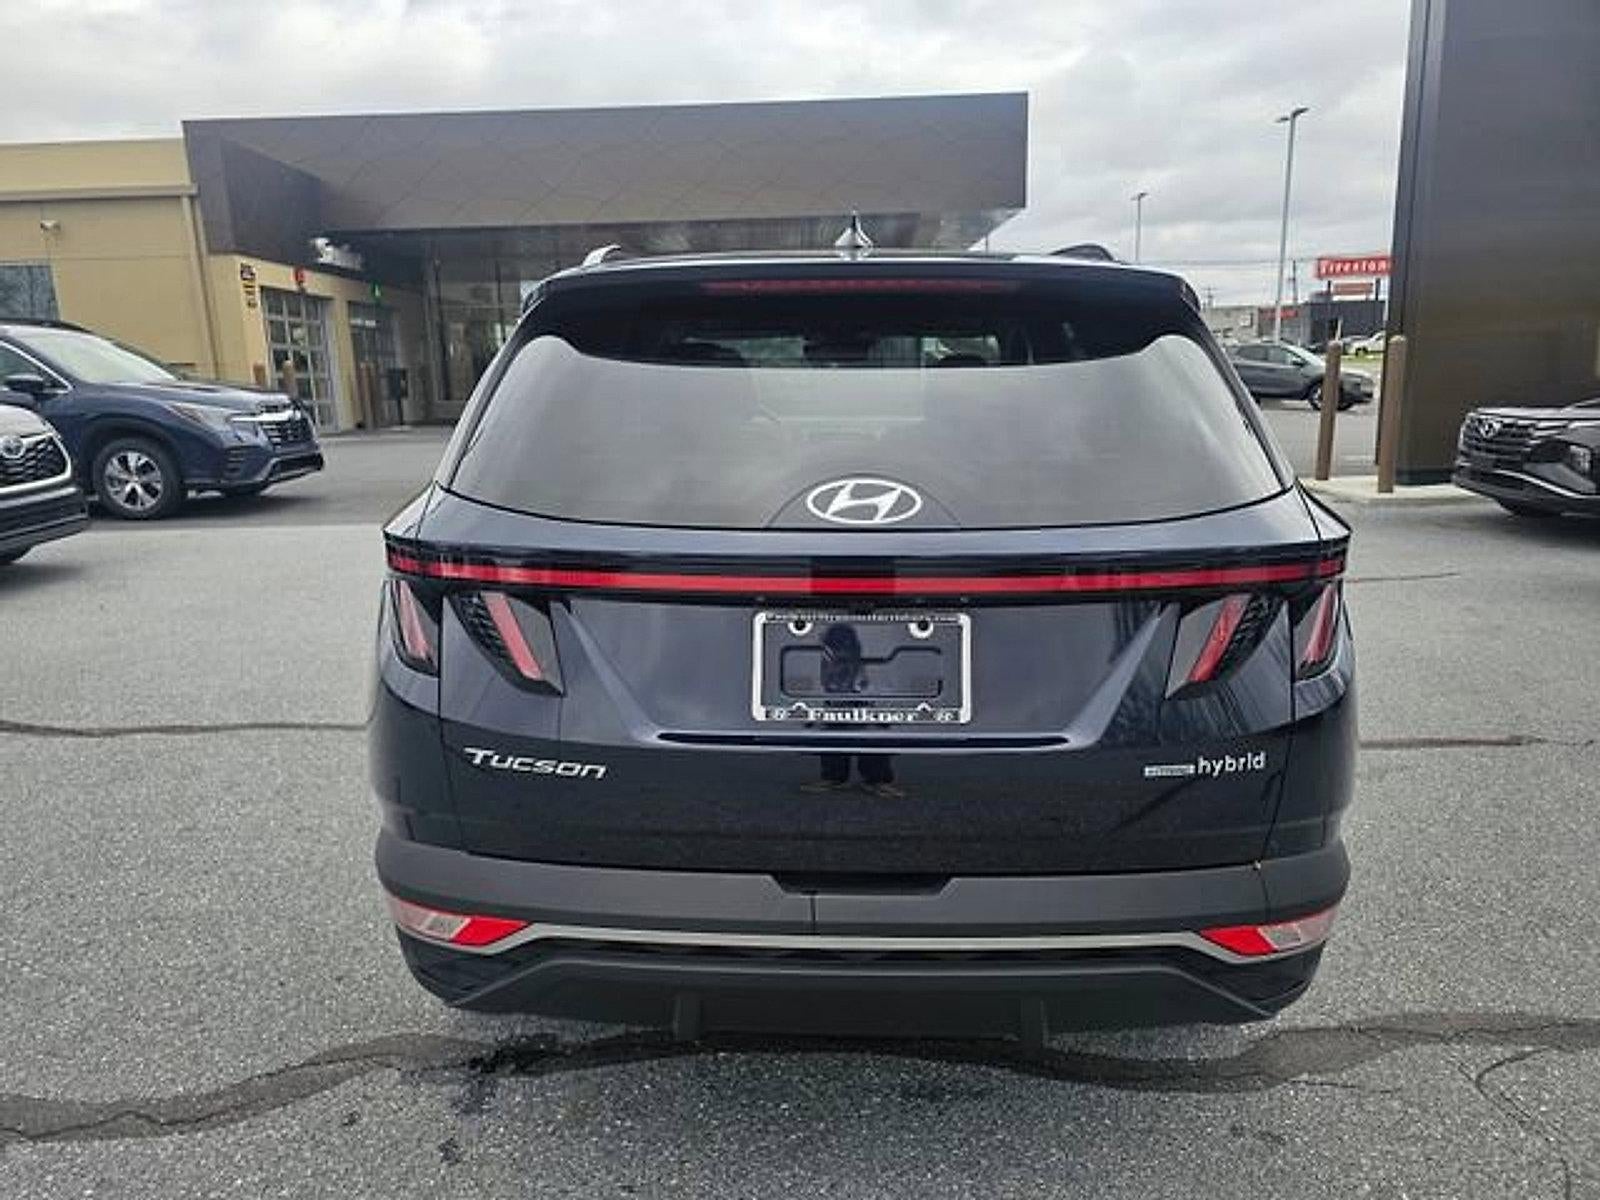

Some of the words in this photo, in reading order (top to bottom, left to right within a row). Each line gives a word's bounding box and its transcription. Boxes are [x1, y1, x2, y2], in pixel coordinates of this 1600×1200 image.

[1320, 258, 1391, 275] Fireston
[806, 706, 917, 723] Faulkner
[1197, 750, 1267, 778] hybrid
